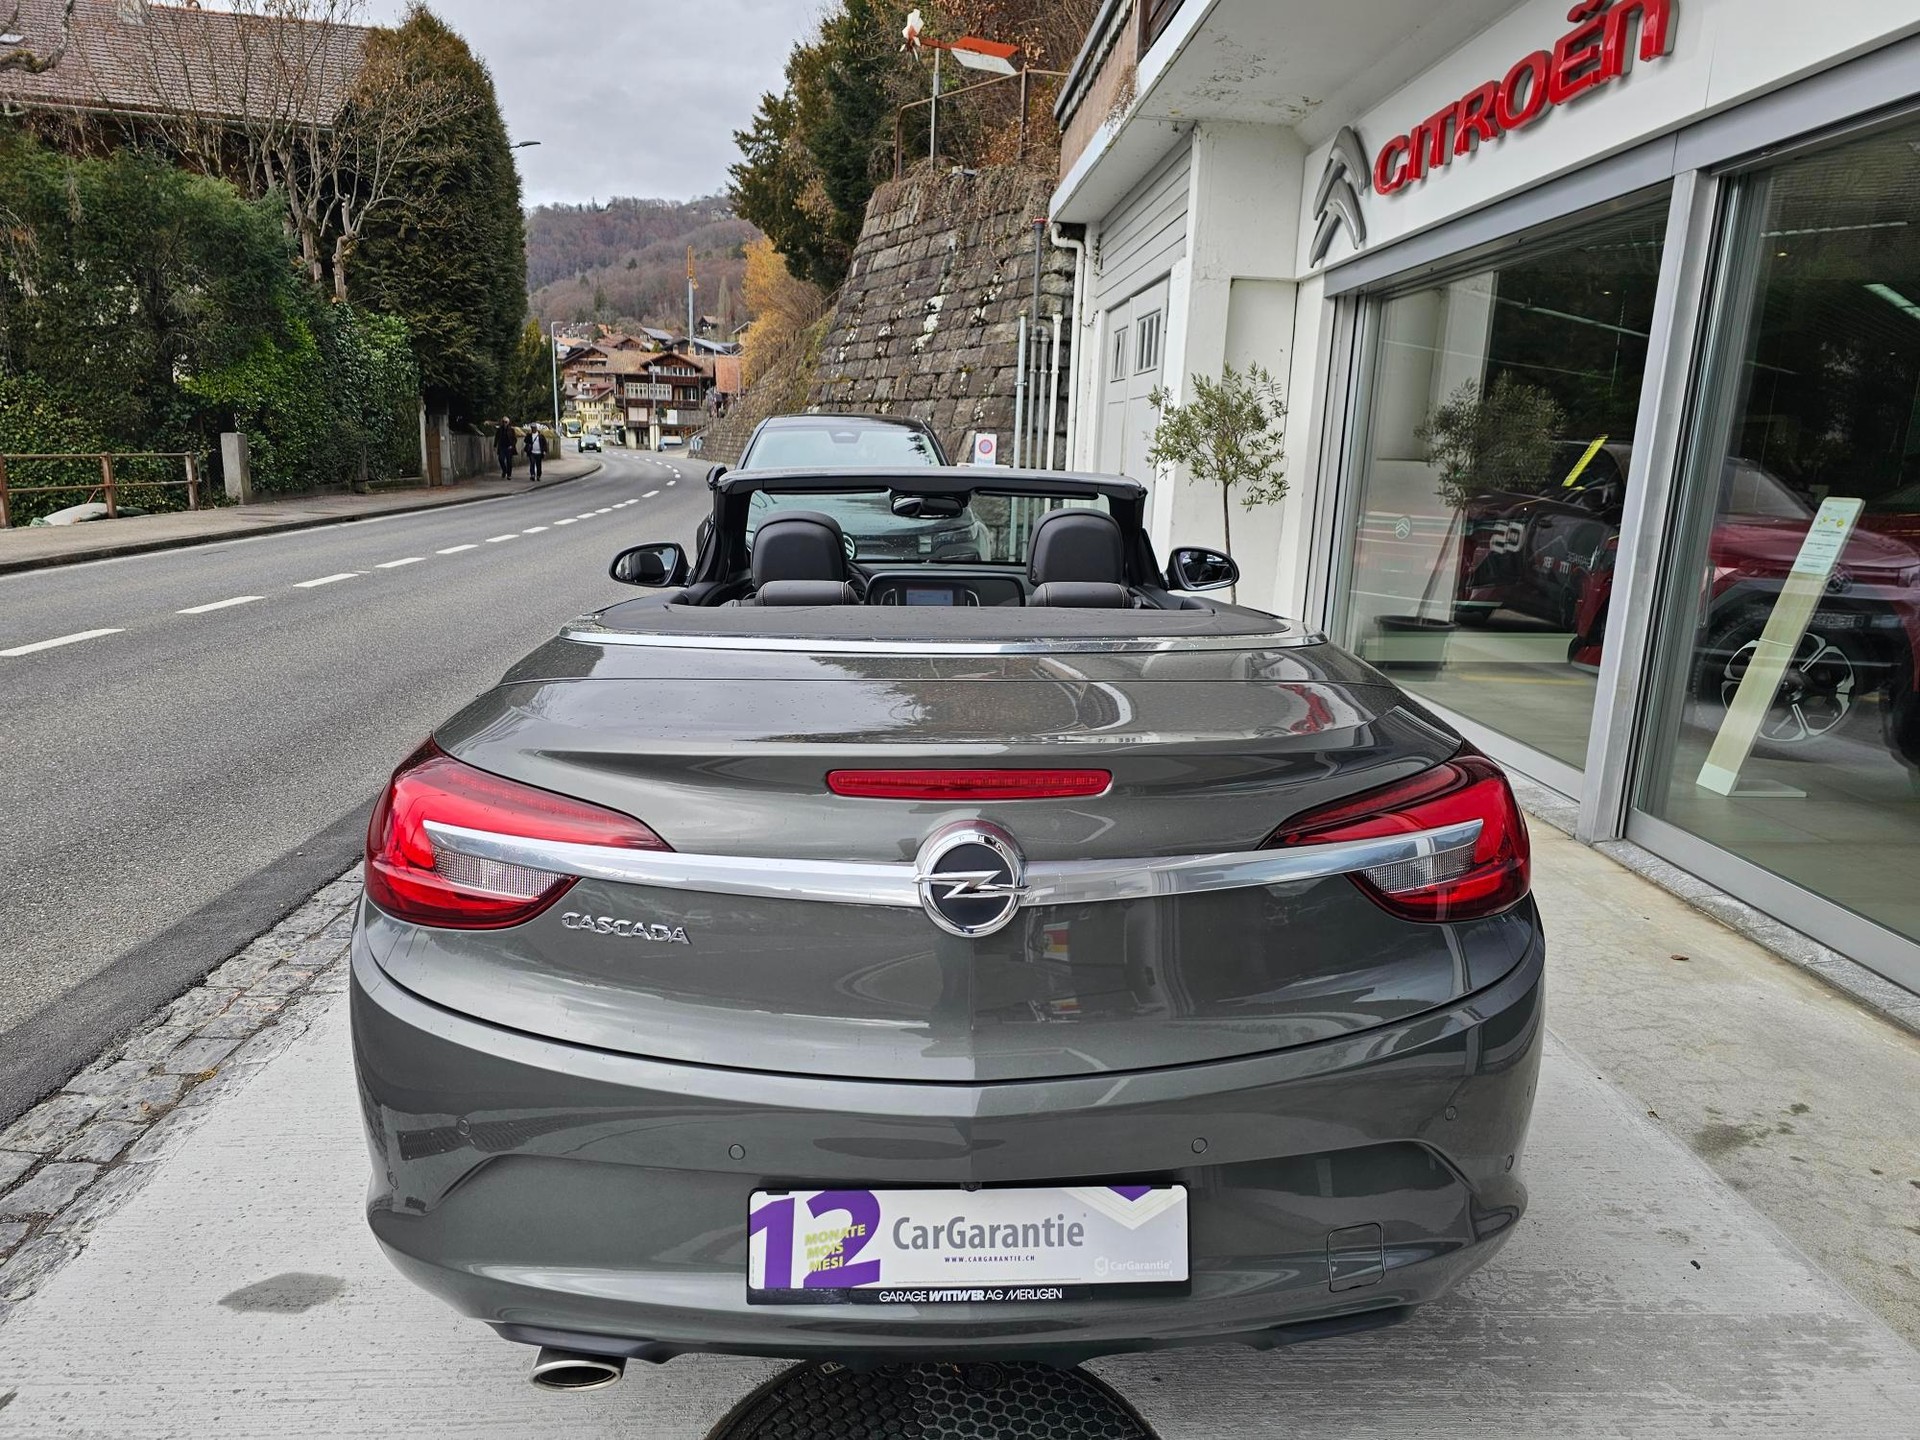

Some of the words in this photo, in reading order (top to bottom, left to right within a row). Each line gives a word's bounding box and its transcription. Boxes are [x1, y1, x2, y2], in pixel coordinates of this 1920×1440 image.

[561, 911, 691, 945] CASCADA
[750, 1189, 881, 1289] 12
[804, 1224, 866, 1245] MONATE
[892, 1213, 1085, 1250] CarGarantie
[806, 1242, 844, 1259] MOIS
[944, 1255, 1035, 1263] WWW.CARGARANTIE.CH
[808, 1256, 844, 1273] MESI
[878, 1290, 927, 1302] GARAGE
[928, 1289, 984, 1302] WITTWER
[985, 1289, 1004, 1301] AG
[1005, 1288, 1063, 1301] MERLIGEN
